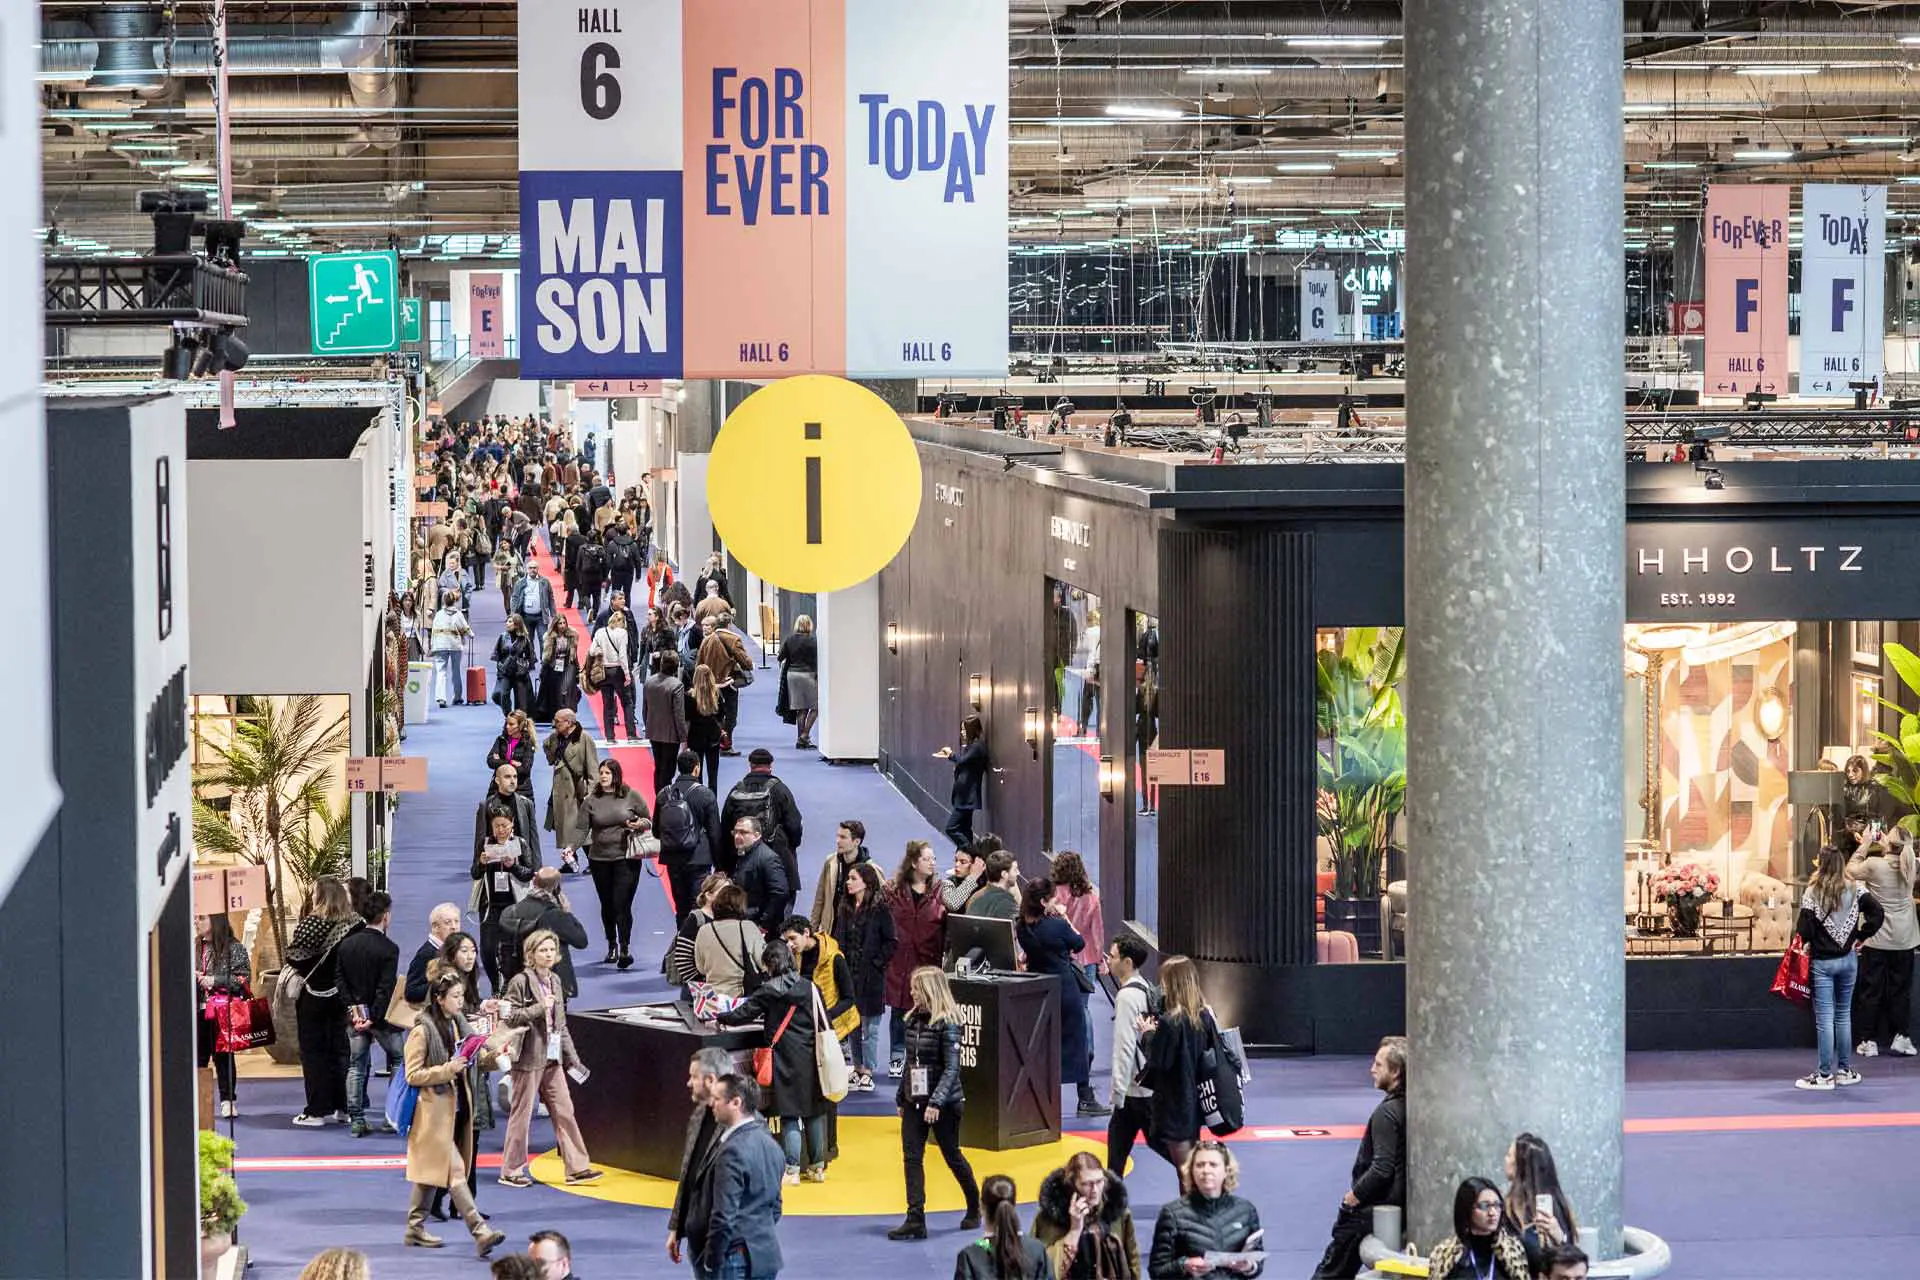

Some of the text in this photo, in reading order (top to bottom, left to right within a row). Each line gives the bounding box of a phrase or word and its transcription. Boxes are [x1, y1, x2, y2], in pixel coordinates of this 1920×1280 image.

[578, 8, 622, 33] HALL
[580, 42, 622, 121] 6
[712, 67, 805, 151] FOR
[858, 93, 996, 204] TODAY
[705, 143, 830, 226] EVER
[536, 198, 665, 275] MAI
[1712, 215, 1783, 249] FOREVER
[1819, 213, 1869, 255] TODAY
[535, 277, 668, 355] SON
[1735, 278, 1759, 333] F
[1831, 278, 1855, 333] F
[482, 310, 493, 332] E
[1311, 307, 1324, 329] G
[739, 343, 790, 363] HALL 6
[902, 342, 952, 362] HALL 6
[1728, 358, 1753, 372] HALL
[1824, 357, 1848, 372] HALL
[602, 380, 636, 392] A L
[1730, 381, 1738, 393] A
[1825, 381, 1833, 392] A
[803, 422, 822, 545] i
[1637, 545, 1863, 575] HHOLTZ
[1660, 592, 1737, 606] EST. 1992
[348, 779, 352, 789] E
[1194, 773, 1199, 781] E
[230, 896, 236, 908] E
[958, 1004, 982, 1026] SON
